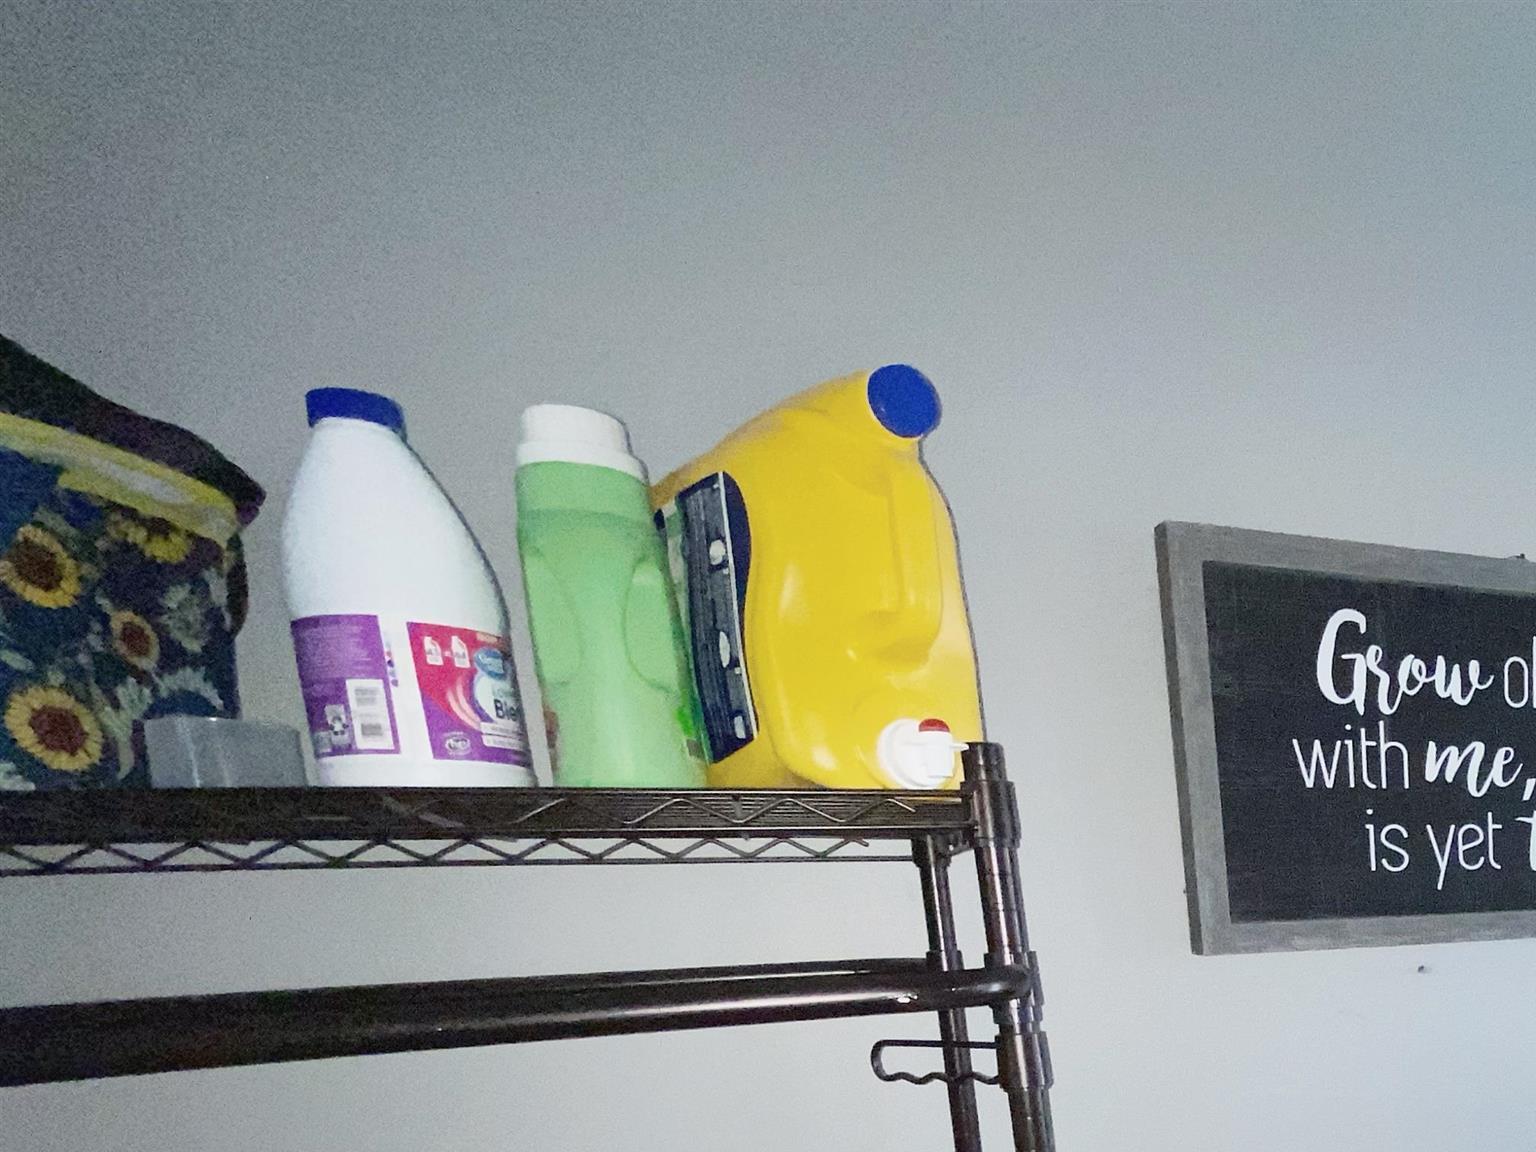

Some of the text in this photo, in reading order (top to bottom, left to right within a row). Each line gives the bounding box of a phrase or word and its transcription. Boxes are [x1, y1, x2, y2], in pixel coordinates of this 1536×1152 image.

[1316, 608, 1495, 716] Grow
[1292, 720, 1410, 789] with
[1424, 740, 1536, 801] me,
[1365, 809, 1410, 872] is
[1425, 811, 1503, 891] yet
